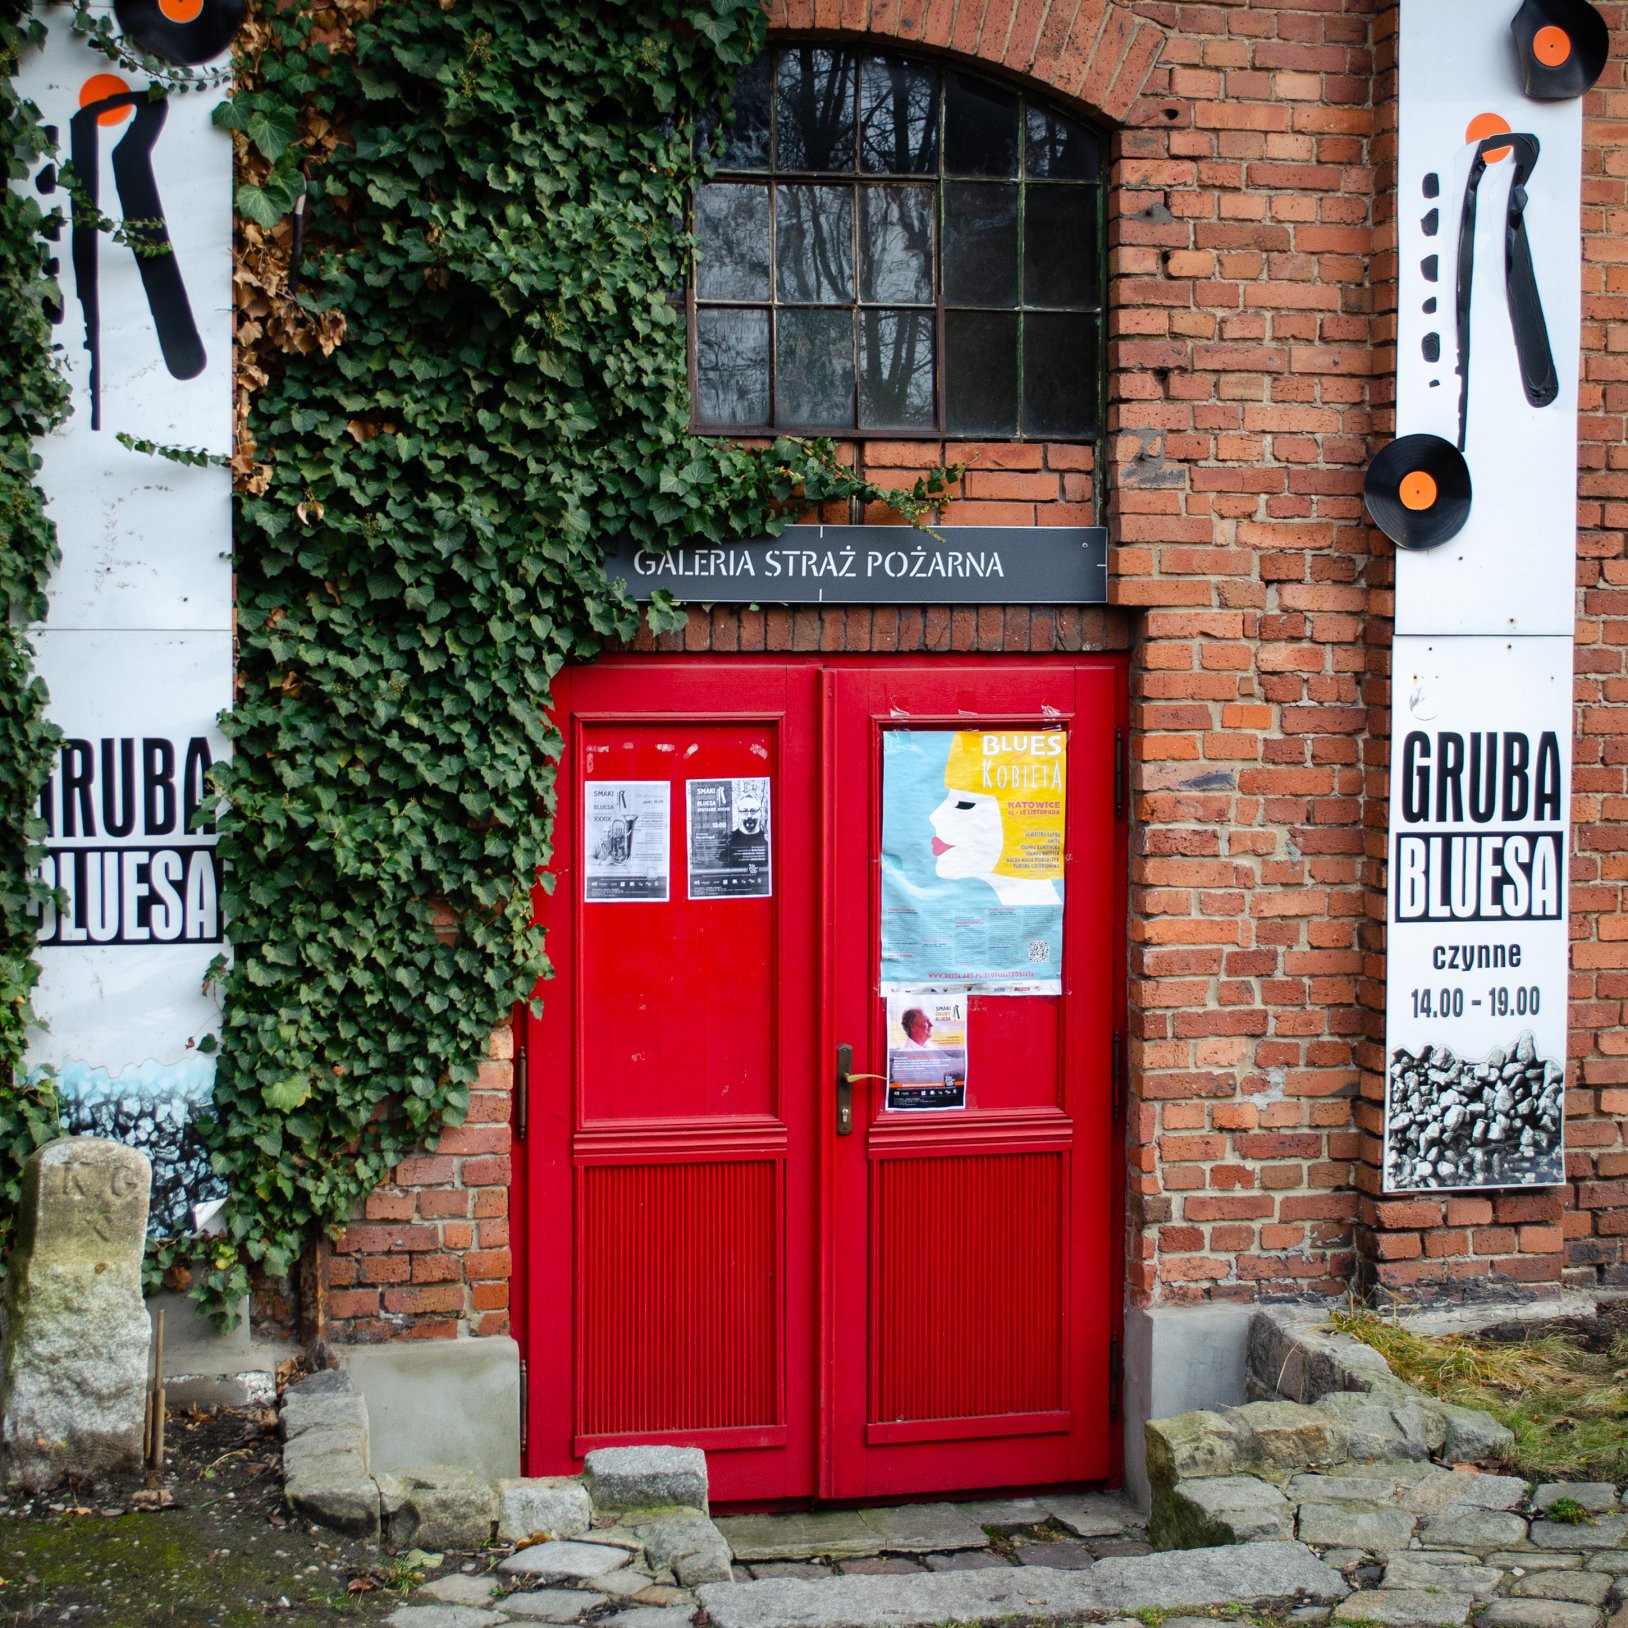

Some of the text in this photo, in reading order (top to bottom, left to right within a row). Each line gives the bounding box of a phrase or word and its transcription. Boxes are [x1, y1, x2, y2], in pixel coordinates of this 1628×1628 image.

[633, 545, 1005, 578] GALERIA STRAŻ POŻARNA
[982, 734, 1062, 757] BLUES
[40, 737, 218, 838] RUBA
[981, 758, 1063, 794] KOBIETĄ
[1401, 730, 1562, 823] GRUBA
[1399, 835, 1558, 919] BLUESA
[1432, 943, 1522, 972] czynne
[1410, 987, 1465, 1019] 14.00
[1488, 985, 1541, 1017] 19.00
